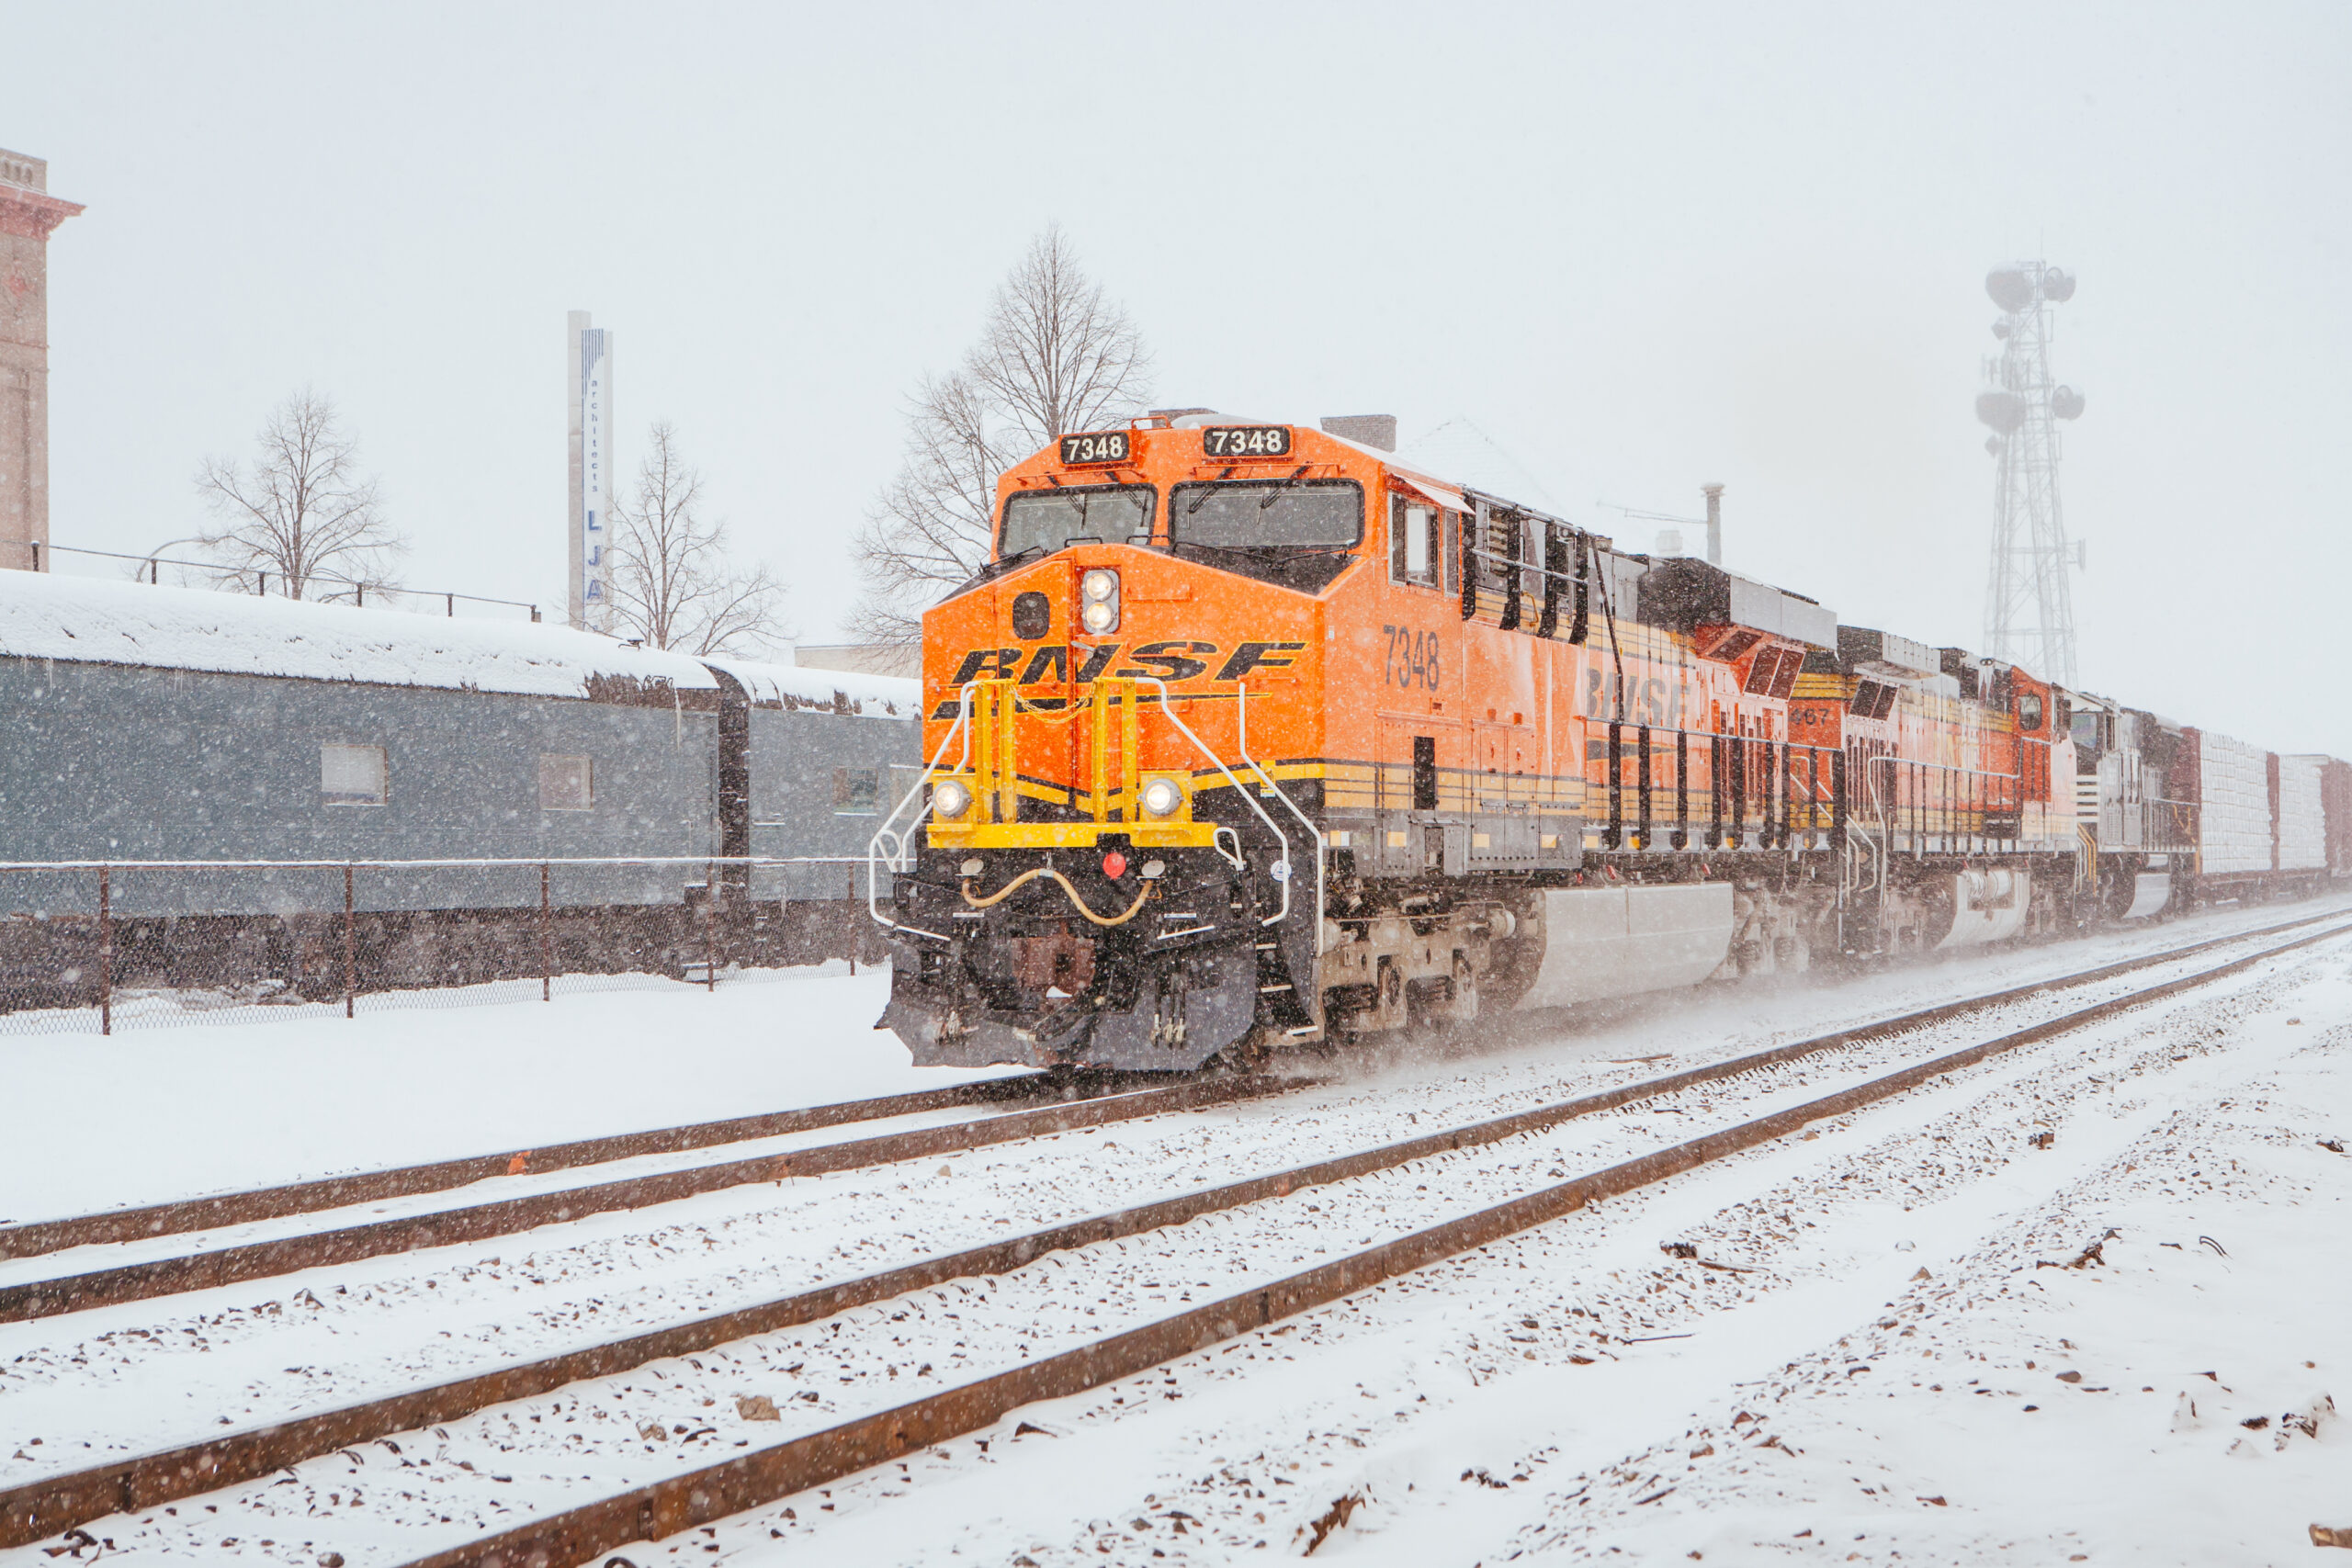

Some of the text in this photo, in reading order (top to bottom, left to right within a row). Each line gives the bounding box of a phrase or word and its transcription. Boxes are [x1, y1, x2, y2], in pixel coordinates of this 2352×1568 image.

[1066, 434, 1124, 461] 7348
[1212, 430, 1283, 454] 7348
[949, 641, 1311, 688] BNSF
[1384, 625, 1440, 692] 7348
